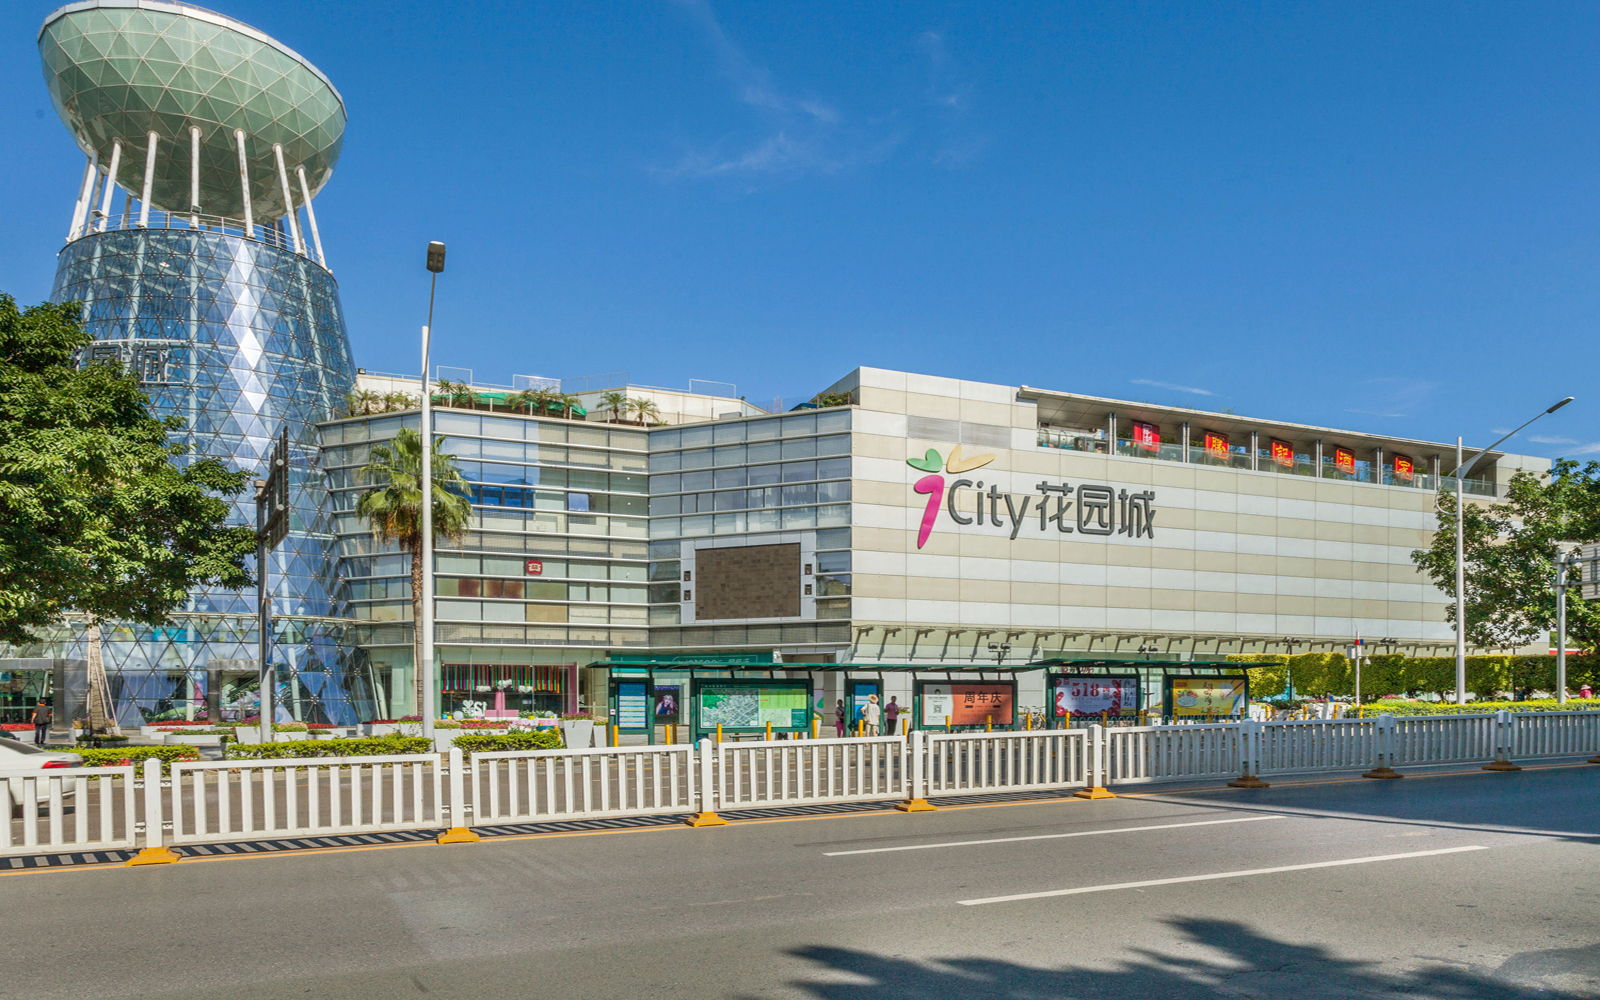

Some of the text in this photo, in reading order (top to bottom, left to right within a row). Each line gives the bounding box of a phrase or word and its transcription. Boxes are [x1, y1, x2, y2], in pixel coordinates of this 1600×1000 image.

[1035, 480, 1157, 540] 花园城
[1071, 682, 1100, 697] 518
[963, 691, 1002, 704] 周年庆
